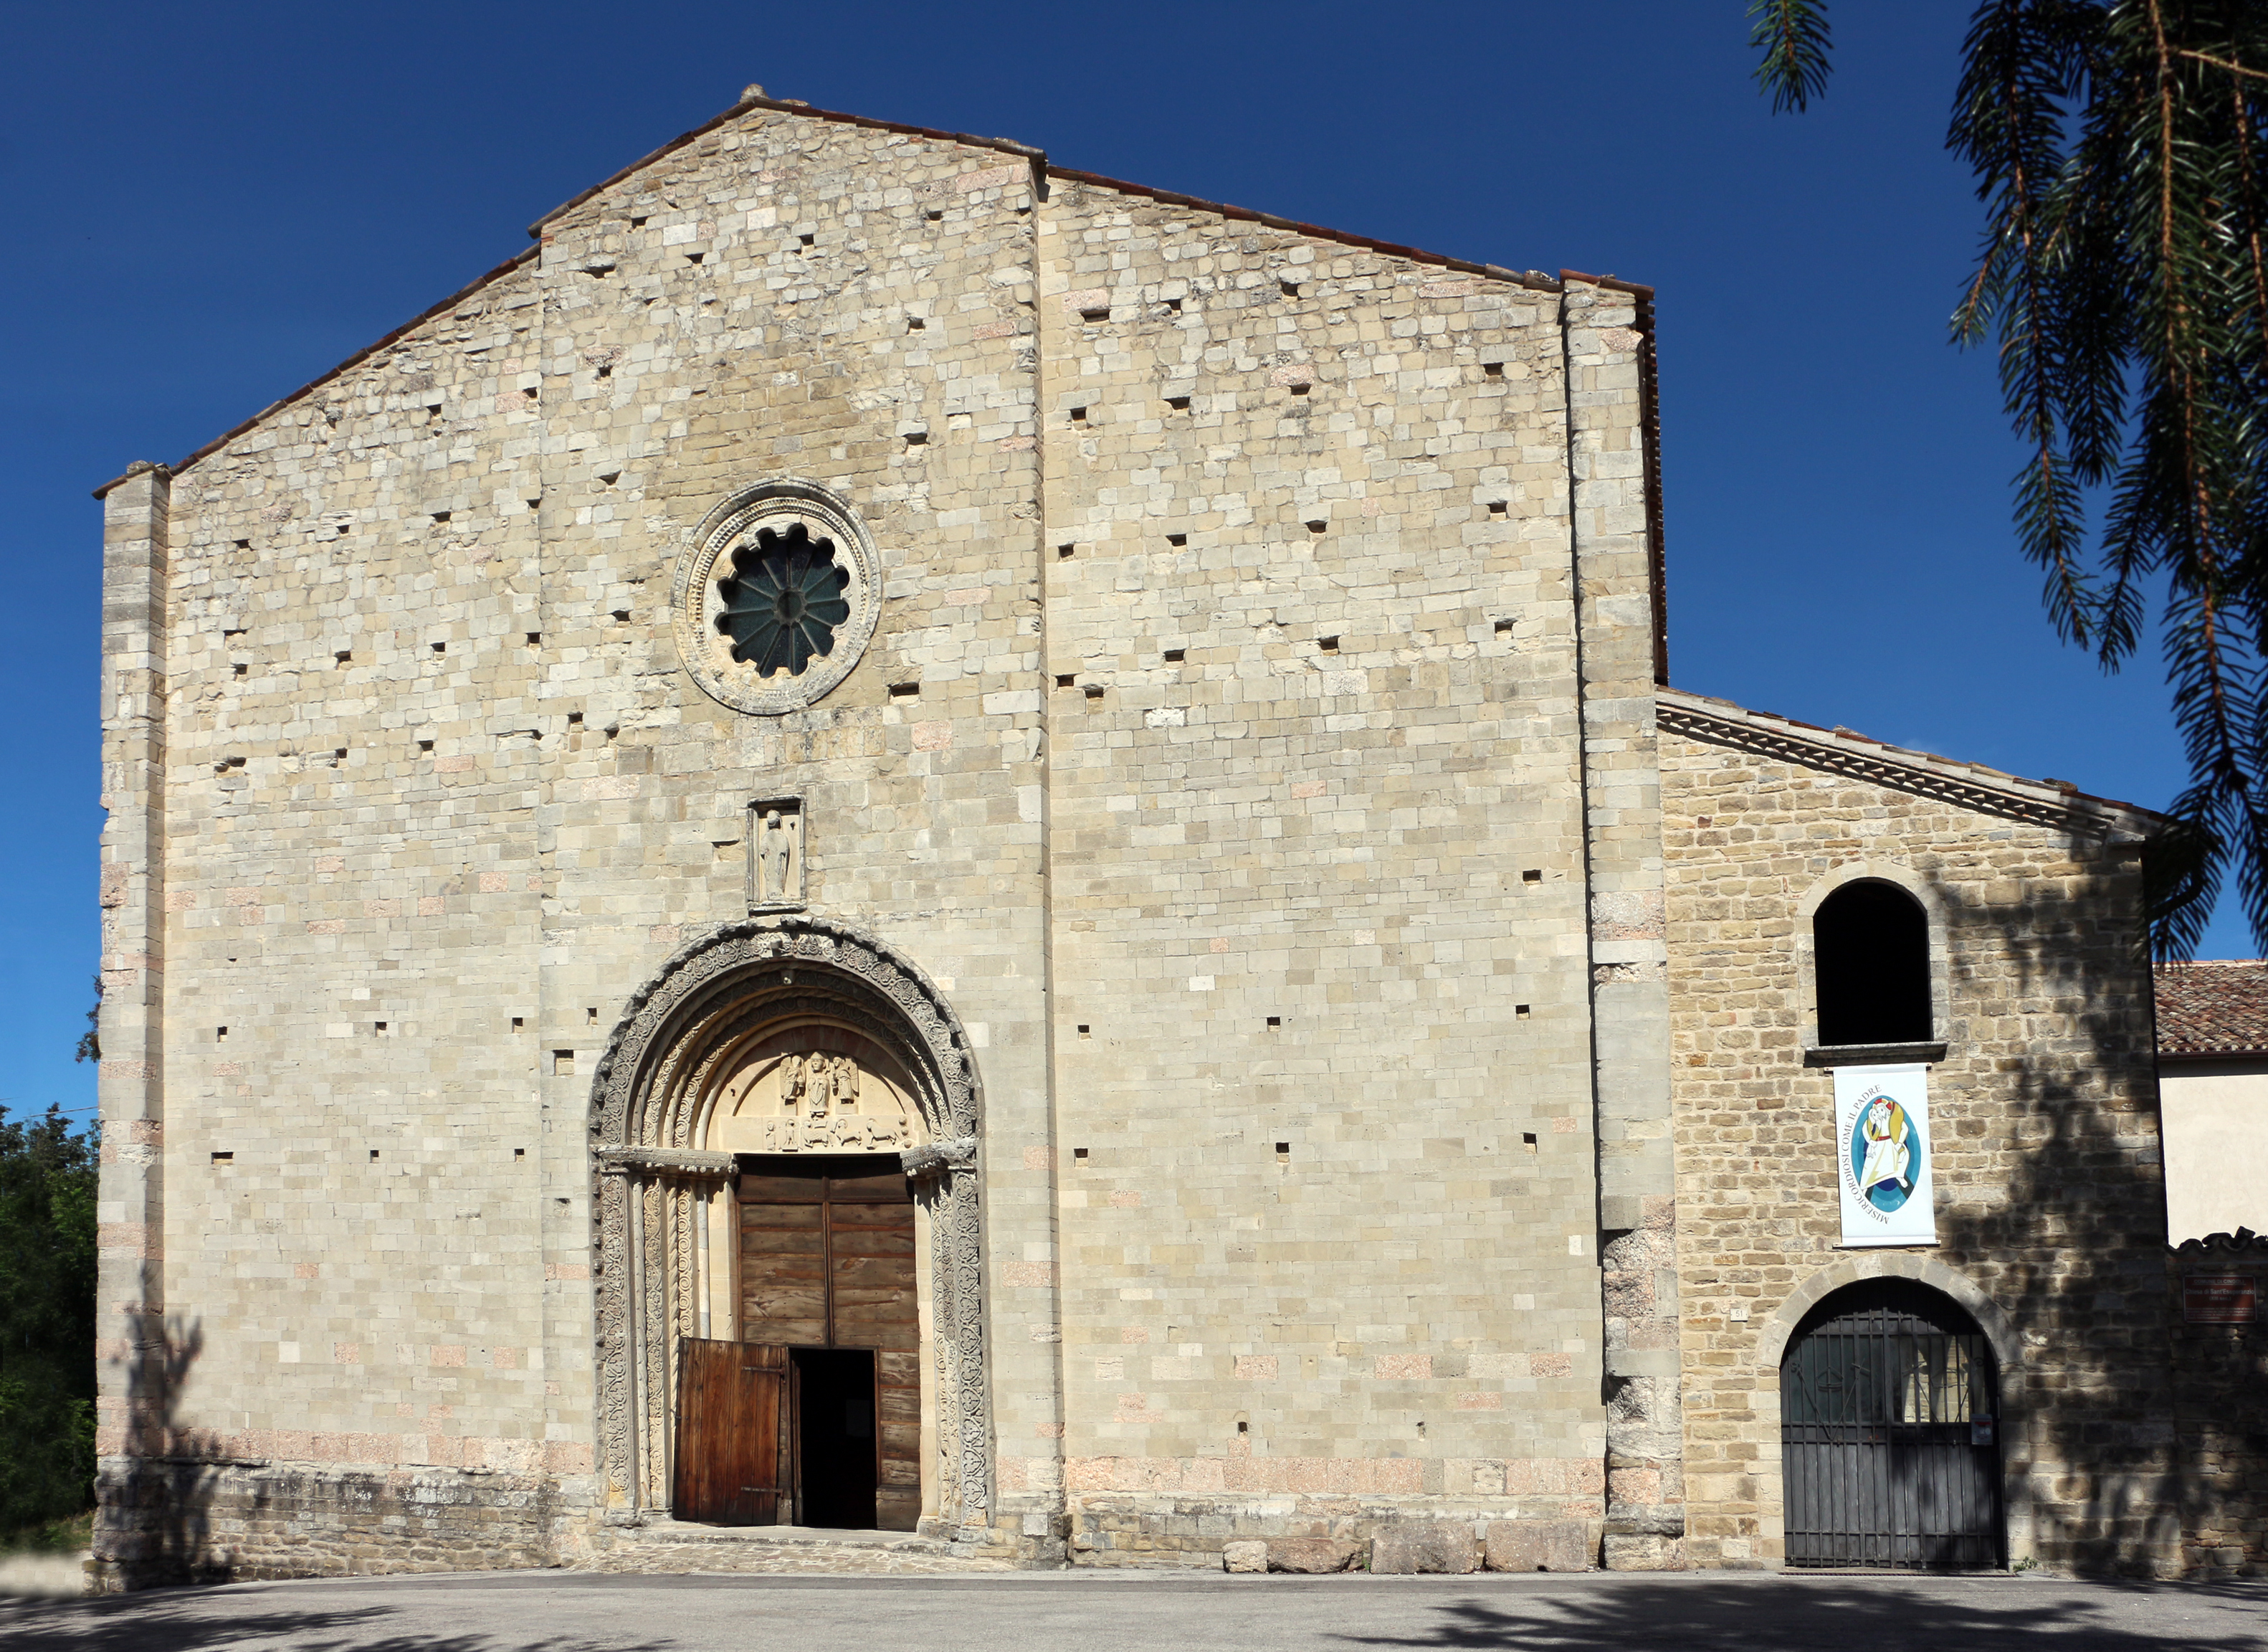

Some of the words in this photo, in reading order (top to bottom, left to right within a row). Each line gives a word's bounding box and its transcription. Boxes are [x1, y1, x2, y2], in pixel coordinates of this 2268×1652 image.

[1853, 1084, 1882, 1110] PADRE
[1848, 1111, 1857, 1120] IL
[1841, 1121, 1853, 1152] COME
[1841, 1154, 1890, 1225] MISERICORDIOSI
